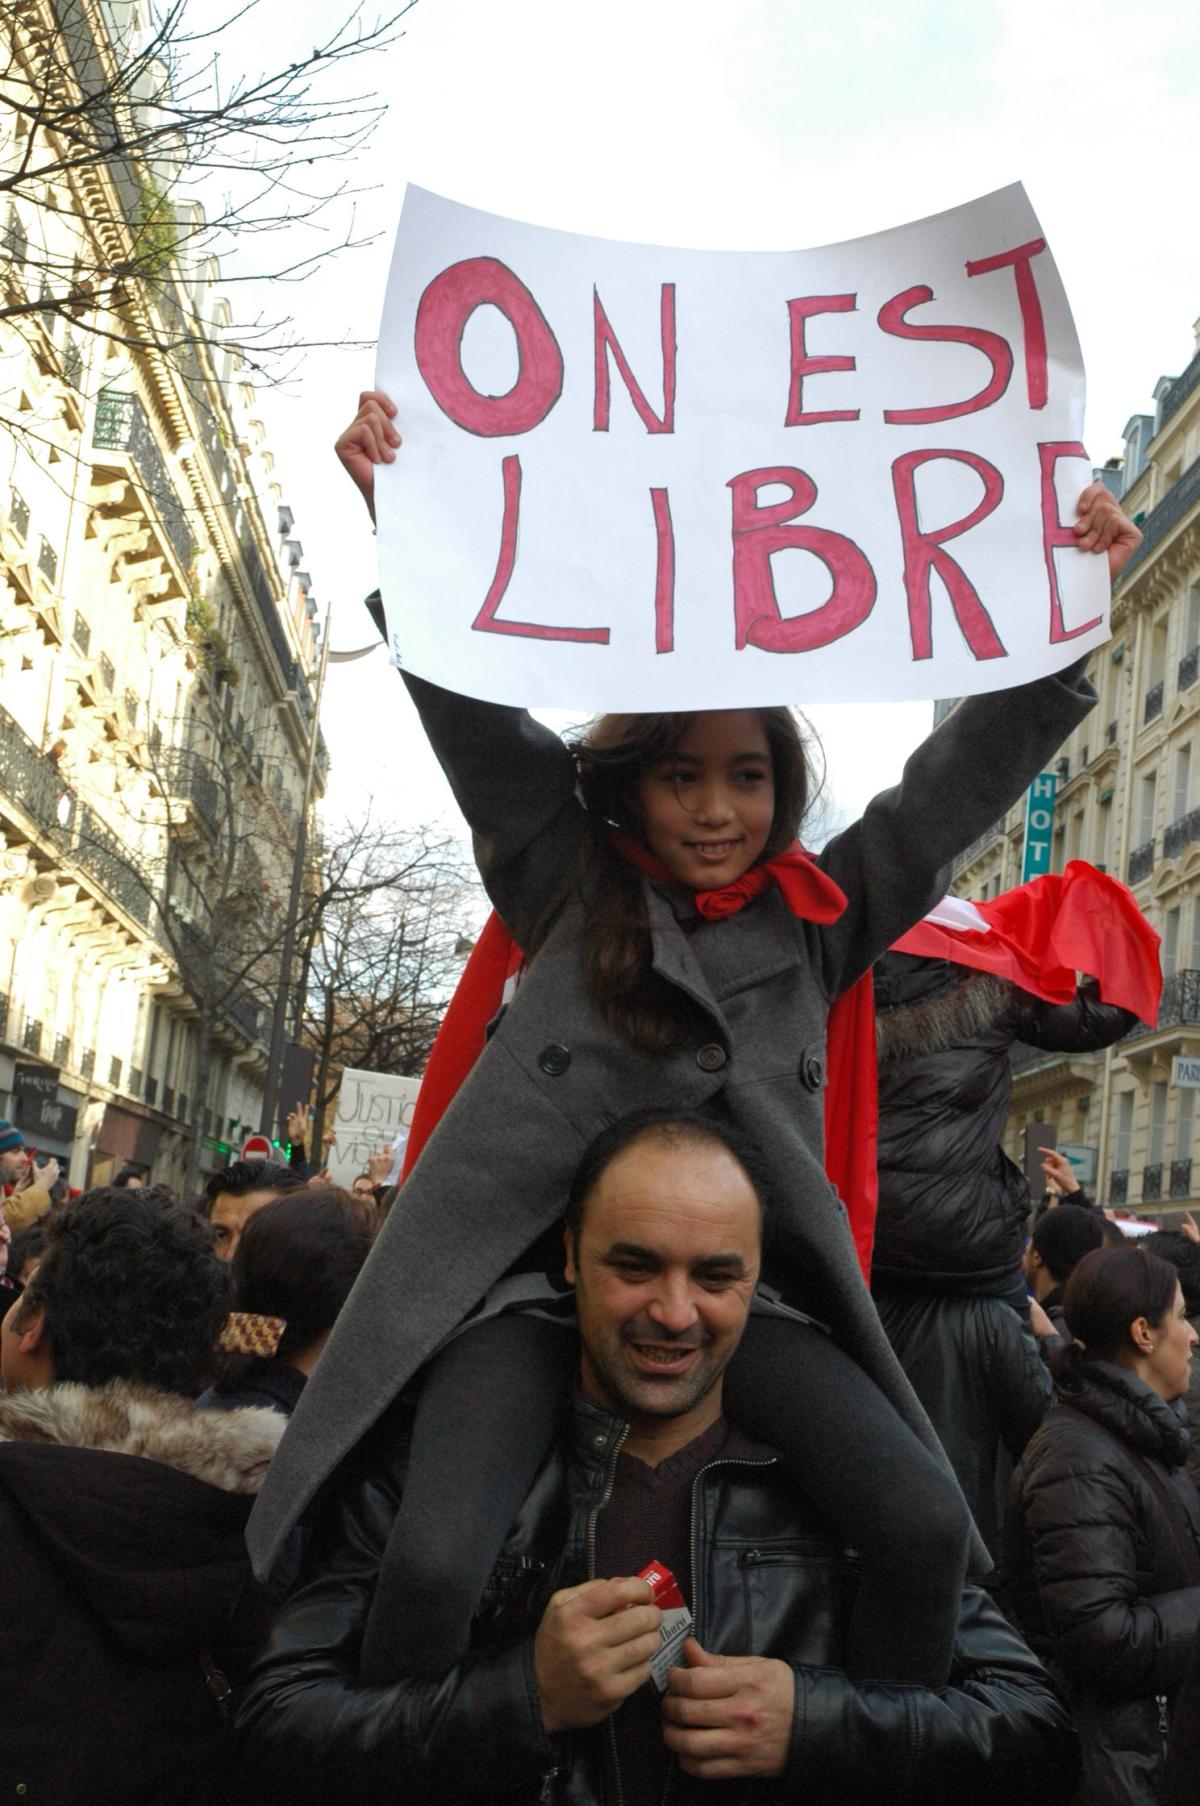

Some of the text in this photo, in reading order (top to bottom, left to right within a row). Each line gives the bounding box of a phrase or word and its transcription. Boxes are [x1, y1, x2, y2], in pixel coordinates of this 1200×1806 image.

[415, 237, 1048, 437] ON EST
[471, 441, 1104, 661] LIBRE
